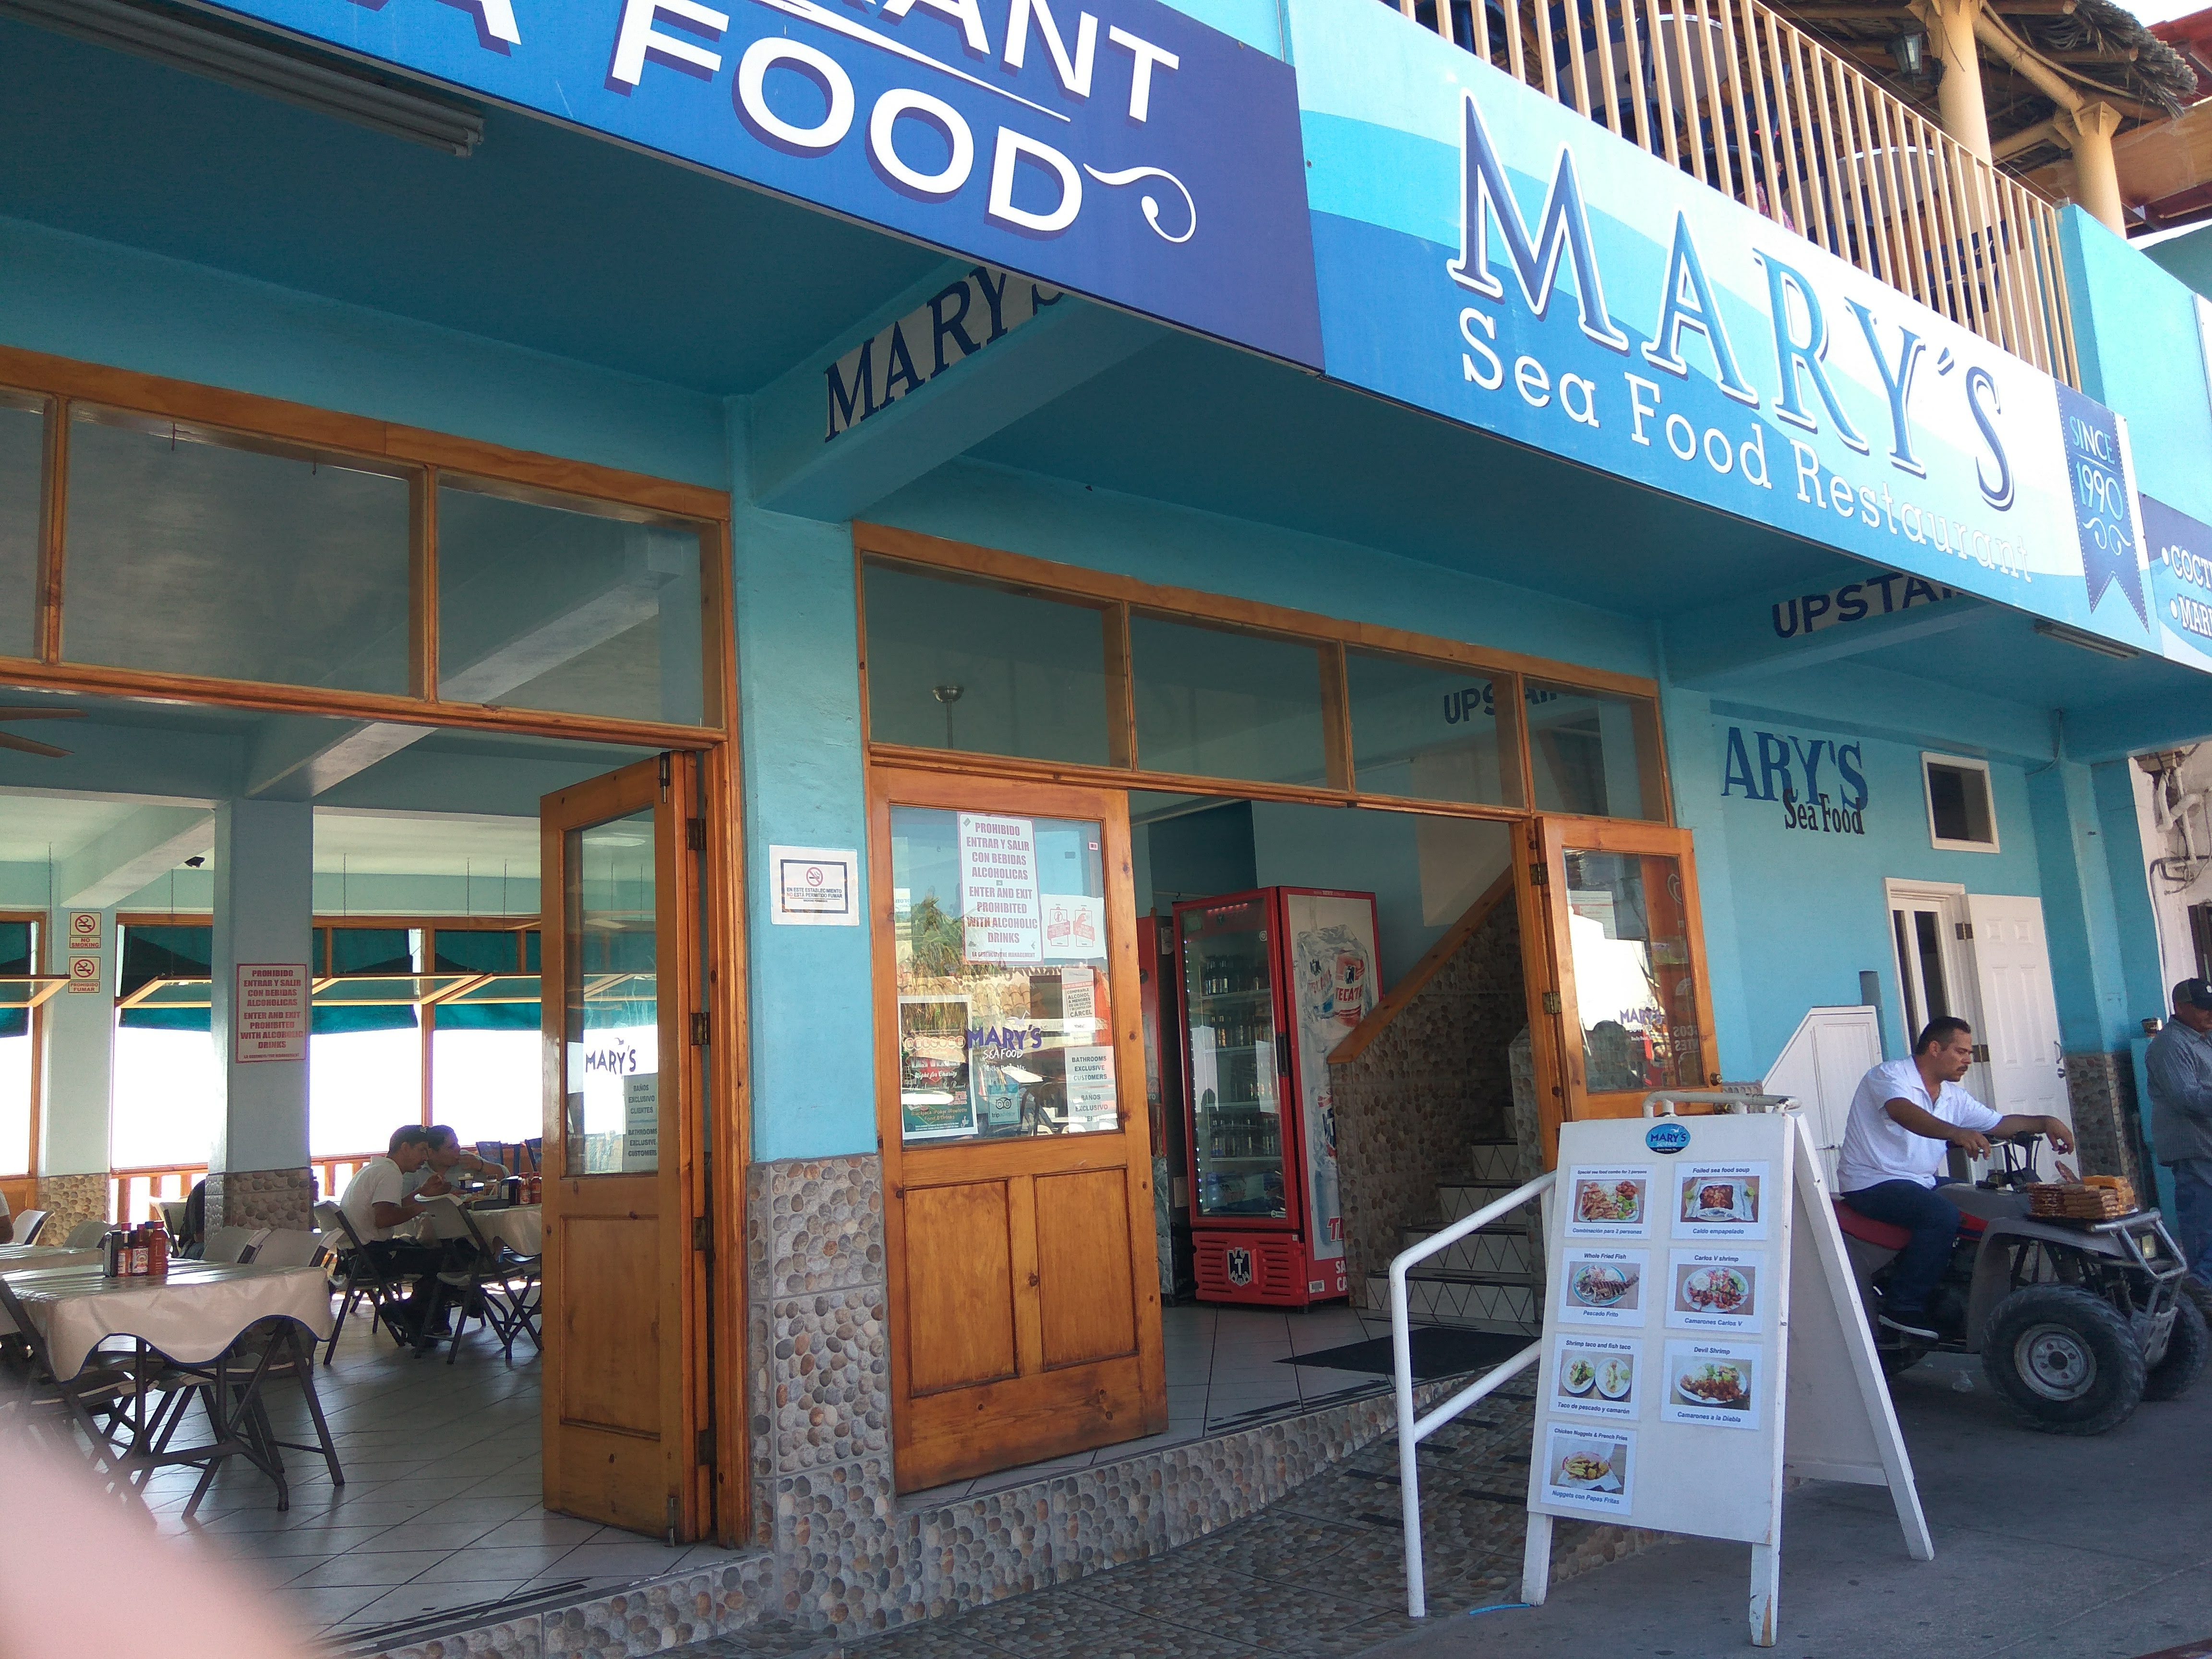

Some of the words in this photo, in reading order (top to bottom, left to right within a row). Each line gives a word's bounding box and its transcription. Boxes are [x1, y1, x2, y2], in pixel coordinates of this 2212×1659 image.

[609, 0, 1083, 234] FOOD
[1446, 87, 2015, 513] MARY'S
[824, 266, 1064, 443] MARY
[1459, 305, 1600, 429] Sea
[1625, 369, 1772, 489] Food
[1795, 451, 2034, 584] Restaurant
[2069, 415, 2116, 466] SINCE
[2076, 460, 2124, 522] 1990
[2170, 544, 2212, 590] COCT
[1772, 572, 1964, 638] UPSTA
[1721, 726, 1868, 812] ARY'S
[1782, 787, 1818, 832] Sea
[1819, 793, 1865, 835] Food
[975, 822, 1020, 836] PROHIBIDO
[966, 837, 999, 849] ENTRAR
[1000, 839, 1006, 849] Y
[1007, 840, 1030, 851] SALIR
[972, 852, 990, 863] CON
[992, 853, 1026, 866] BEBIDAS
[972, 867, 1028, 880] ALCOHOLICAS
[969, 886, 995, 898] ENTER
[997, 888, 1014, 899] AND
[1016, 888, 1033, 899] EXIT
[977, 902, 1027, 914] PROHIBITED
[966, 916, 990, 927] WITH
[992, 917, 1038, 929] ALCOHOLIC
[987, 932, 1020, 943] DRINKS
[250, 1021, 295, 1029] PROHIBITED
[263, 1031, 303, 1039] ALCOHOLIC
[966, 1024, 1042, 1050] MARY'S
[258, 1041, 287, 1049] DRINKS
[586, 1045, 636, 1075] MARY'S
[938, 1070, 957, 1079] Charity
[628, 1095, 655, 1103] EXCLUSIVO
[1650, 1131, 1687, 1142] MARY'S
[1709, 1347, 1731, 1356] Shrimp
[1677, 1411, 1709, 1420] Camarones
[1552, 1490, 1574, 1498] Nuggets
[1586, 1494, 1603, 1503] Papas
[1604, 1496, 1620, 1504] Fritas
